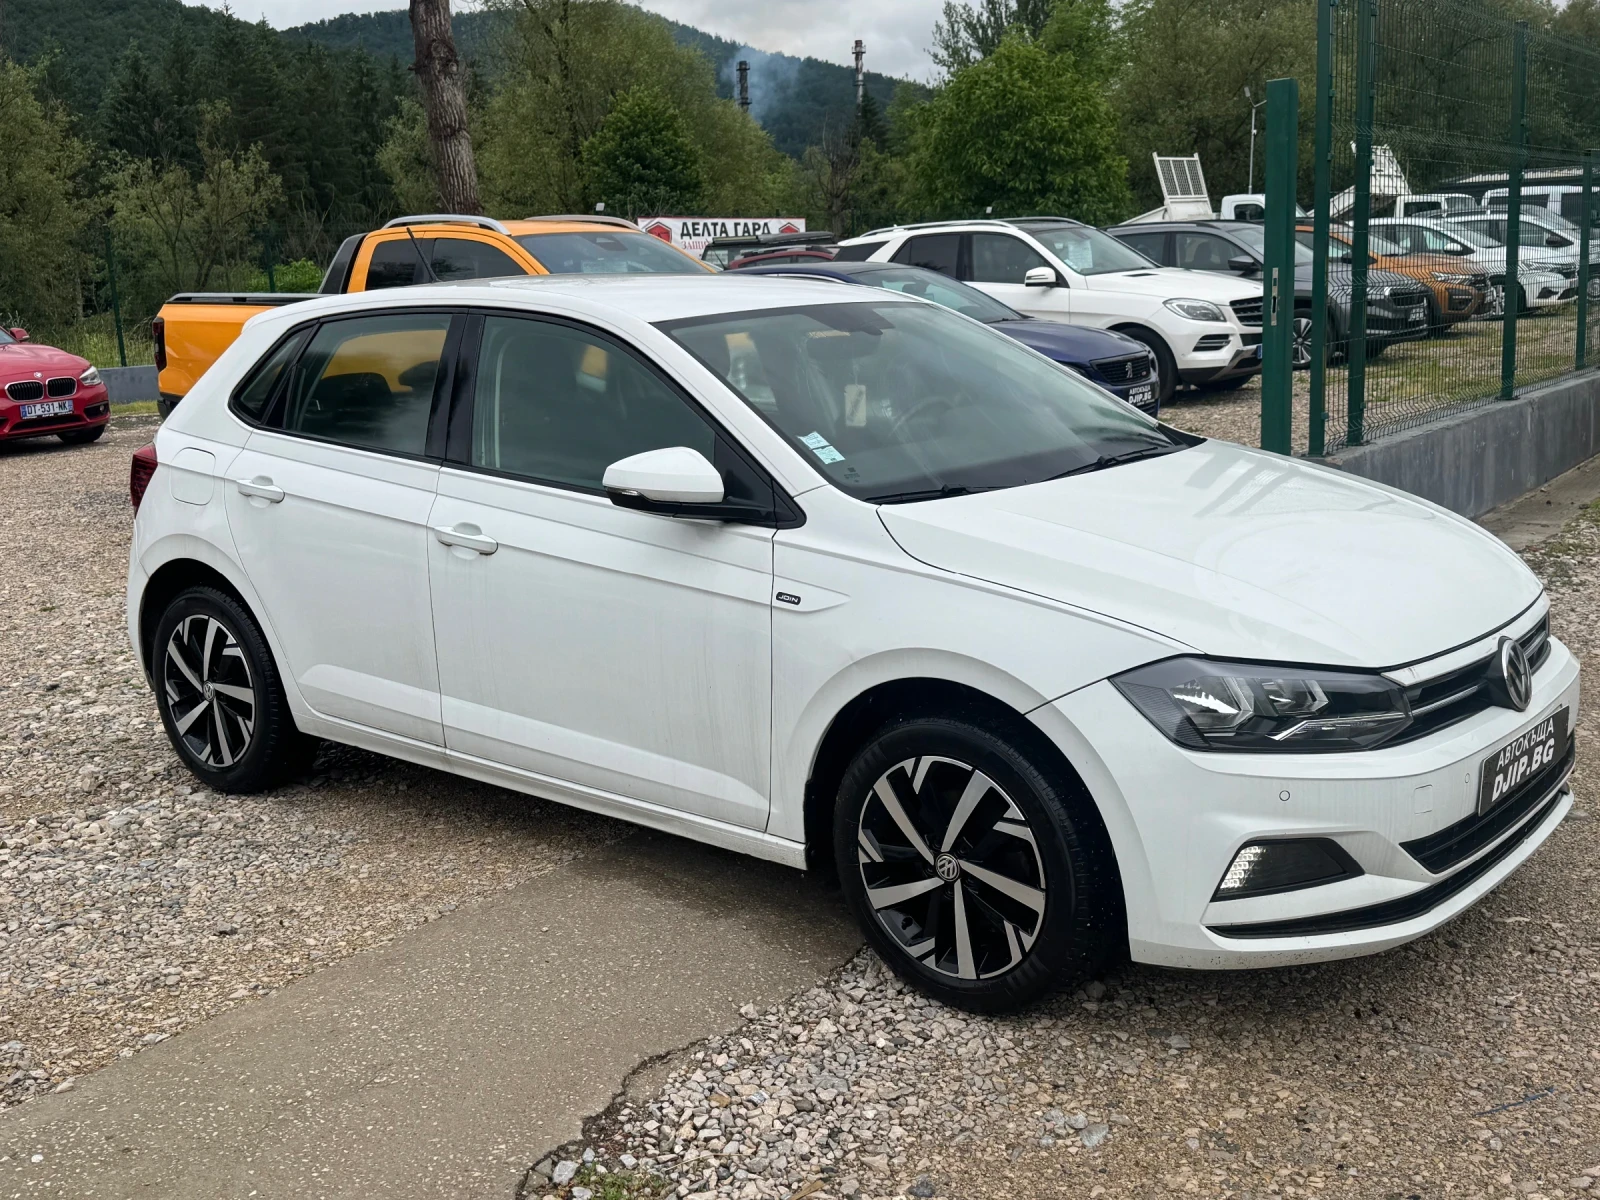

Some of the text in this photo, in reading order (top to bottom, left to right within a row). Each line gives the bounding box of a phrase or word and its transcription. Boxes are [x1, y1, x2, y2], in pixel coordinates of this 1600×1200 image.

[680, 222, 729, 239] ДЕЛТА
[1129, 391, 1152, 404] DJIP.BG
[27, 402, 68, 415] DT-531-NK
[778, 595, 798, 603] JOIN
[1496, 717, 1555, 772] АВТОКЪЩА
[1491, 737, 1556, 803] DJIP.BG
